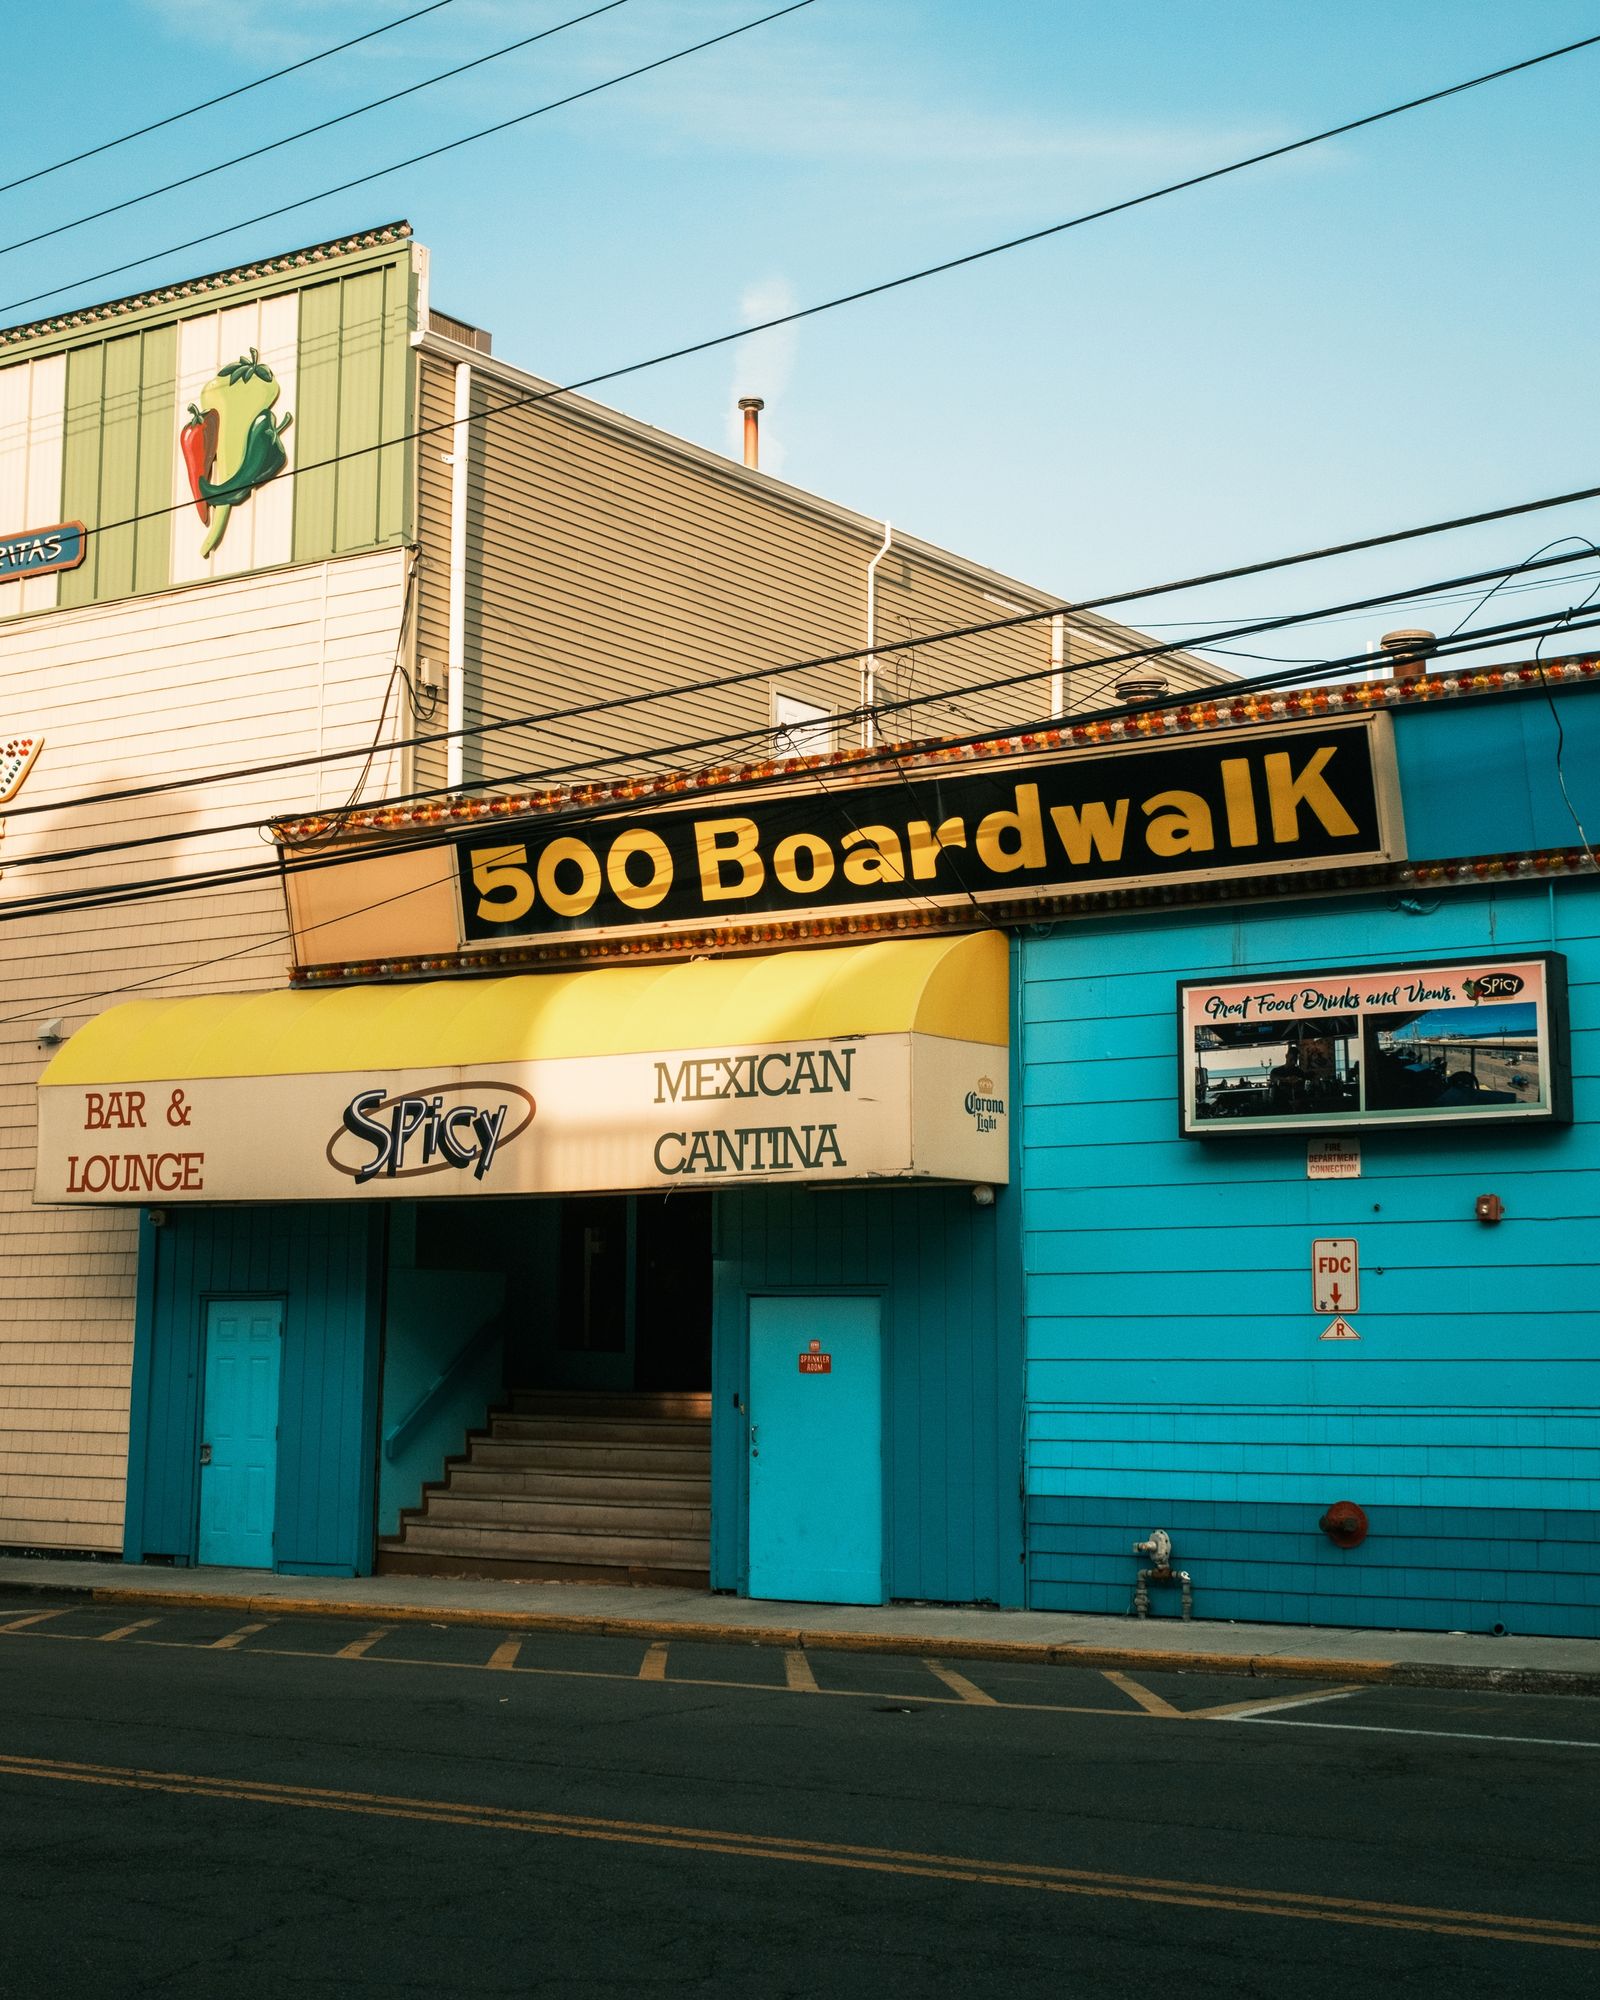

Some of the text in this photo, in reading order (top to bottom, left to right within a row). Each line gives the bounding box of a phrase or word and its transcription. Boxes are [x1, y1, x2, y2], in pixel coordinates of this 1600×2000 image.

[470, 828, 674, 923] 500
[1204, 978, 1457, 1019] Great Food Drinks and Views.
[653, 1048, 857, 1104] MEXICAN
[84, 1088, 191, 1130] BAR &
[964, 1091, 1005, 1117] Corona
[976, 1113, 997, 1133] Light
[653, 1123, 847, 1175] CANTINA
[1308, 1153, 1359, 1163] DEPARTMENT
[1324, 1142, 1342, 1152] FIRE
[66, 1151, 205, 1193] LOUNGE
[1310, 1164, 1357, 1173] CONNECTION
[1318, 1256, 1352, 1274] FDC
[1336, 1323, 1346, 1337] R
